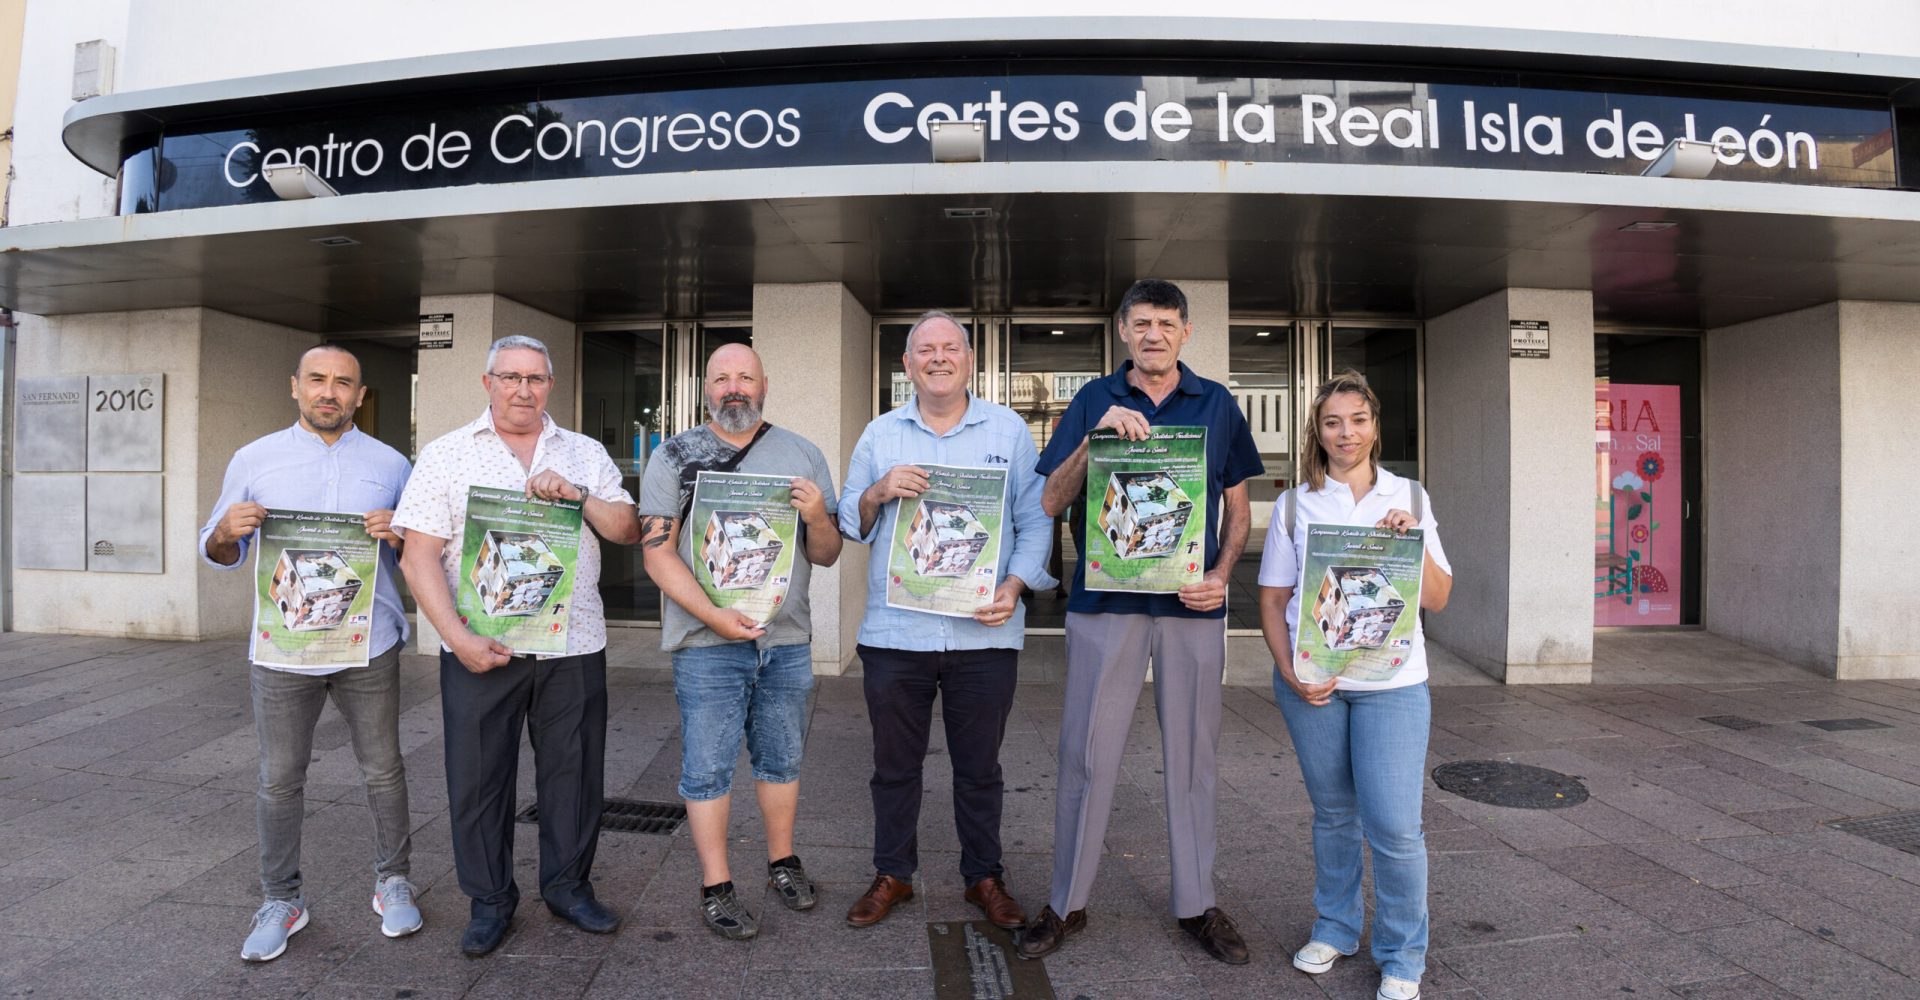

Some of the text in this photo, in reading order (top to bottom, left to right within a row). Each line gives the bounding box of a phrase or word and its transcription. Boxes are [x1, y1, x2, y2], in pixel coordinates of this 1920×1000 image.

[223, 132, 384, 188] Centro
[400, 122, 472, 172] de
[489, 107, 801, 169] Congresos
[863, 90, 1080, 144] Cortes
[1103, 90, 1193, 142] de
[1216, 91, 1276, 144] la
[1301, 93, 1440, 149] Real
[1463, 100, 1564, 155] Isla
[1585, 108, 1664, 162] de
[23, 392, 80, 401] SAN FERNANDO
[1636, 433, 1661, 452] Sal
